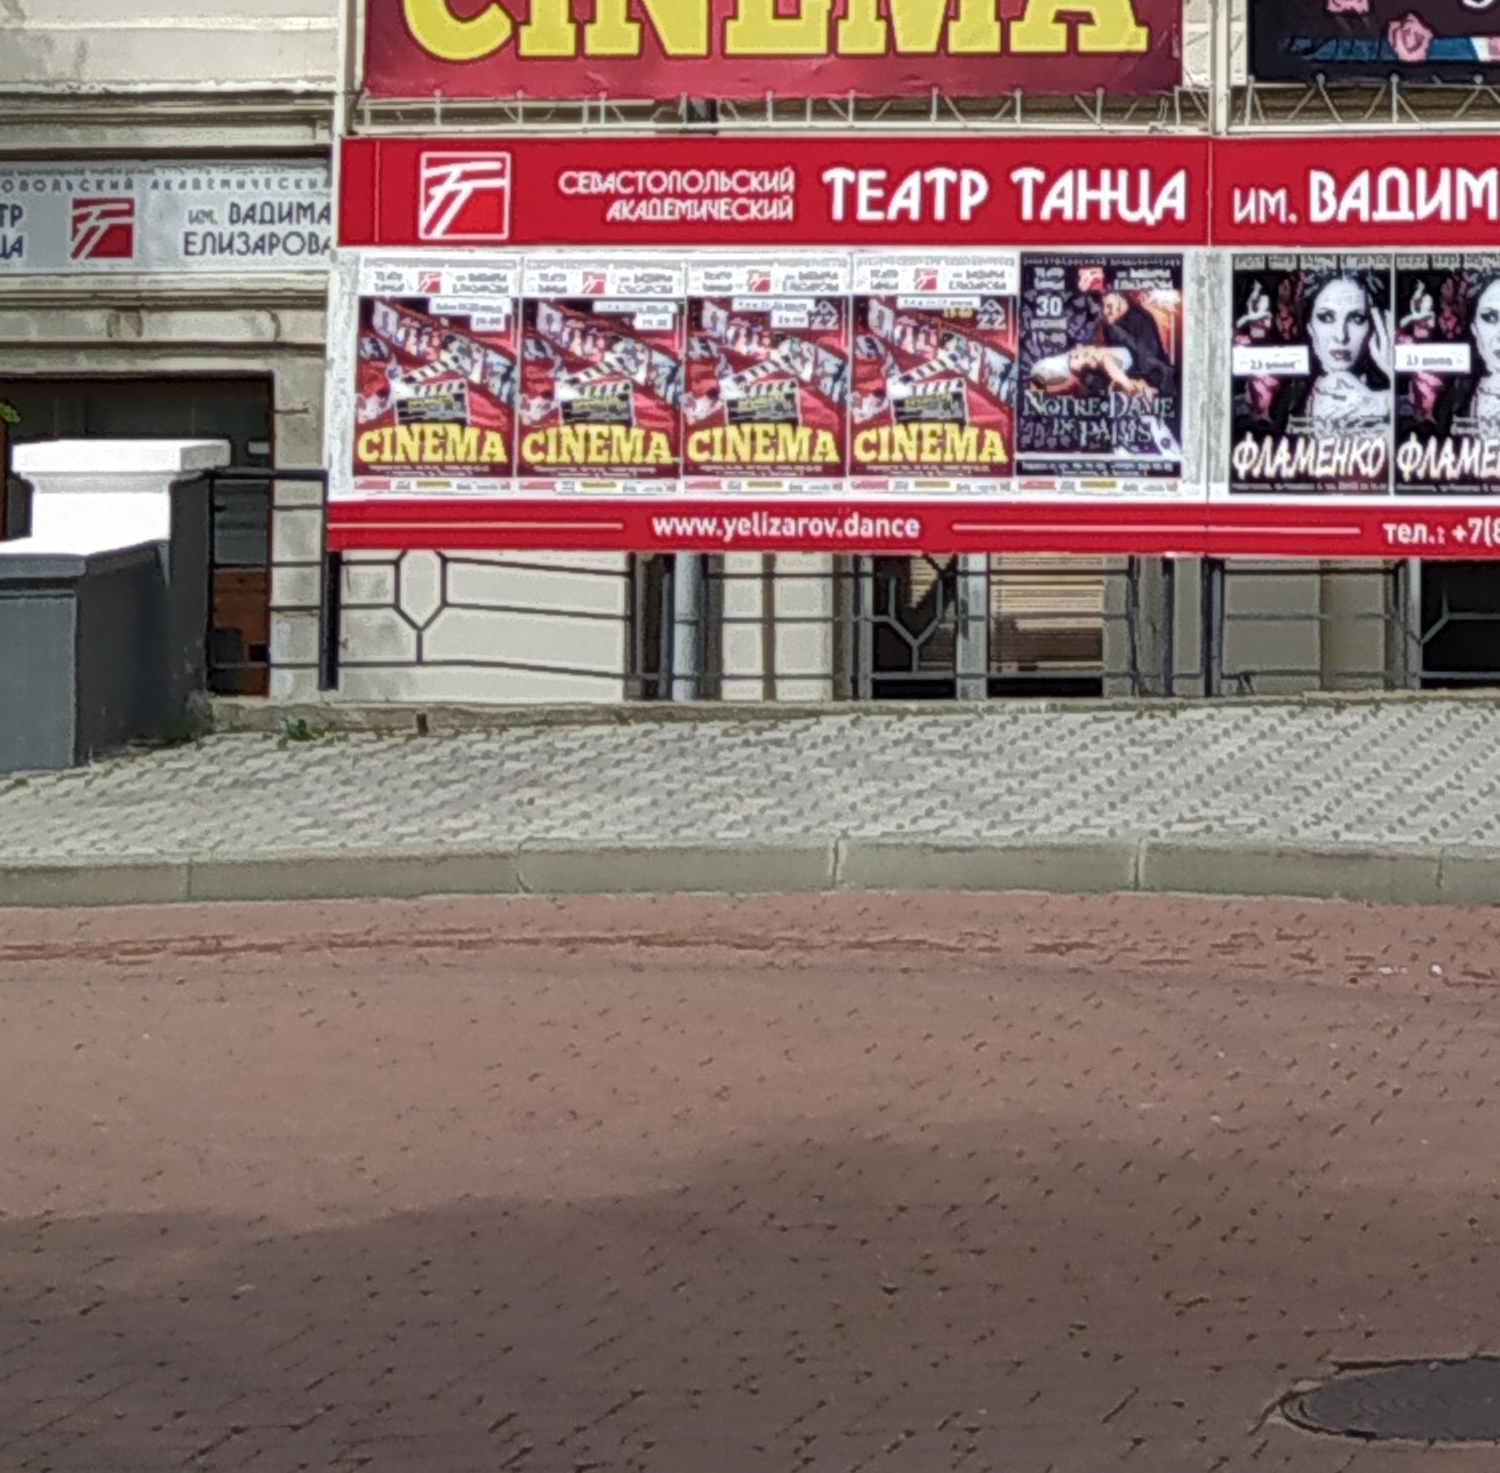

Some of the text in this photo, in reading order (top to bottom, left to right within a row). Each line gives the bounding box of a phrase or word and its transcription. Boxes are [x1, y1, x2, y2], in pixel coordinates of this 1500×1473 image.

[558, 166, 796, 195] СЕВАСТОПОЛЬСКИЙ
[821, 166, 991, 222] ТЕАТР
[1011, 167, 1187, 227] ТАНЦА
[1232, 184, 1298, 225] им.
[228, 201, 332, 226] ВАДИМА
[605, 195, 795, 222] АКАДЕМИЧЕСКИЙ
[357, 422, 509, 464] CINEMA
[521, 423, 673, 465] CINEMA
[686, 422, 841, 464] CINEMA
[853, 422, 1009, 464] CINEMA
[1232, 432, 1388, 480] ФЛАМЕНКО
[651, 512, 921, 544] www.yelizarov.dance
[1383, 521, 1446, 546] тел.:
